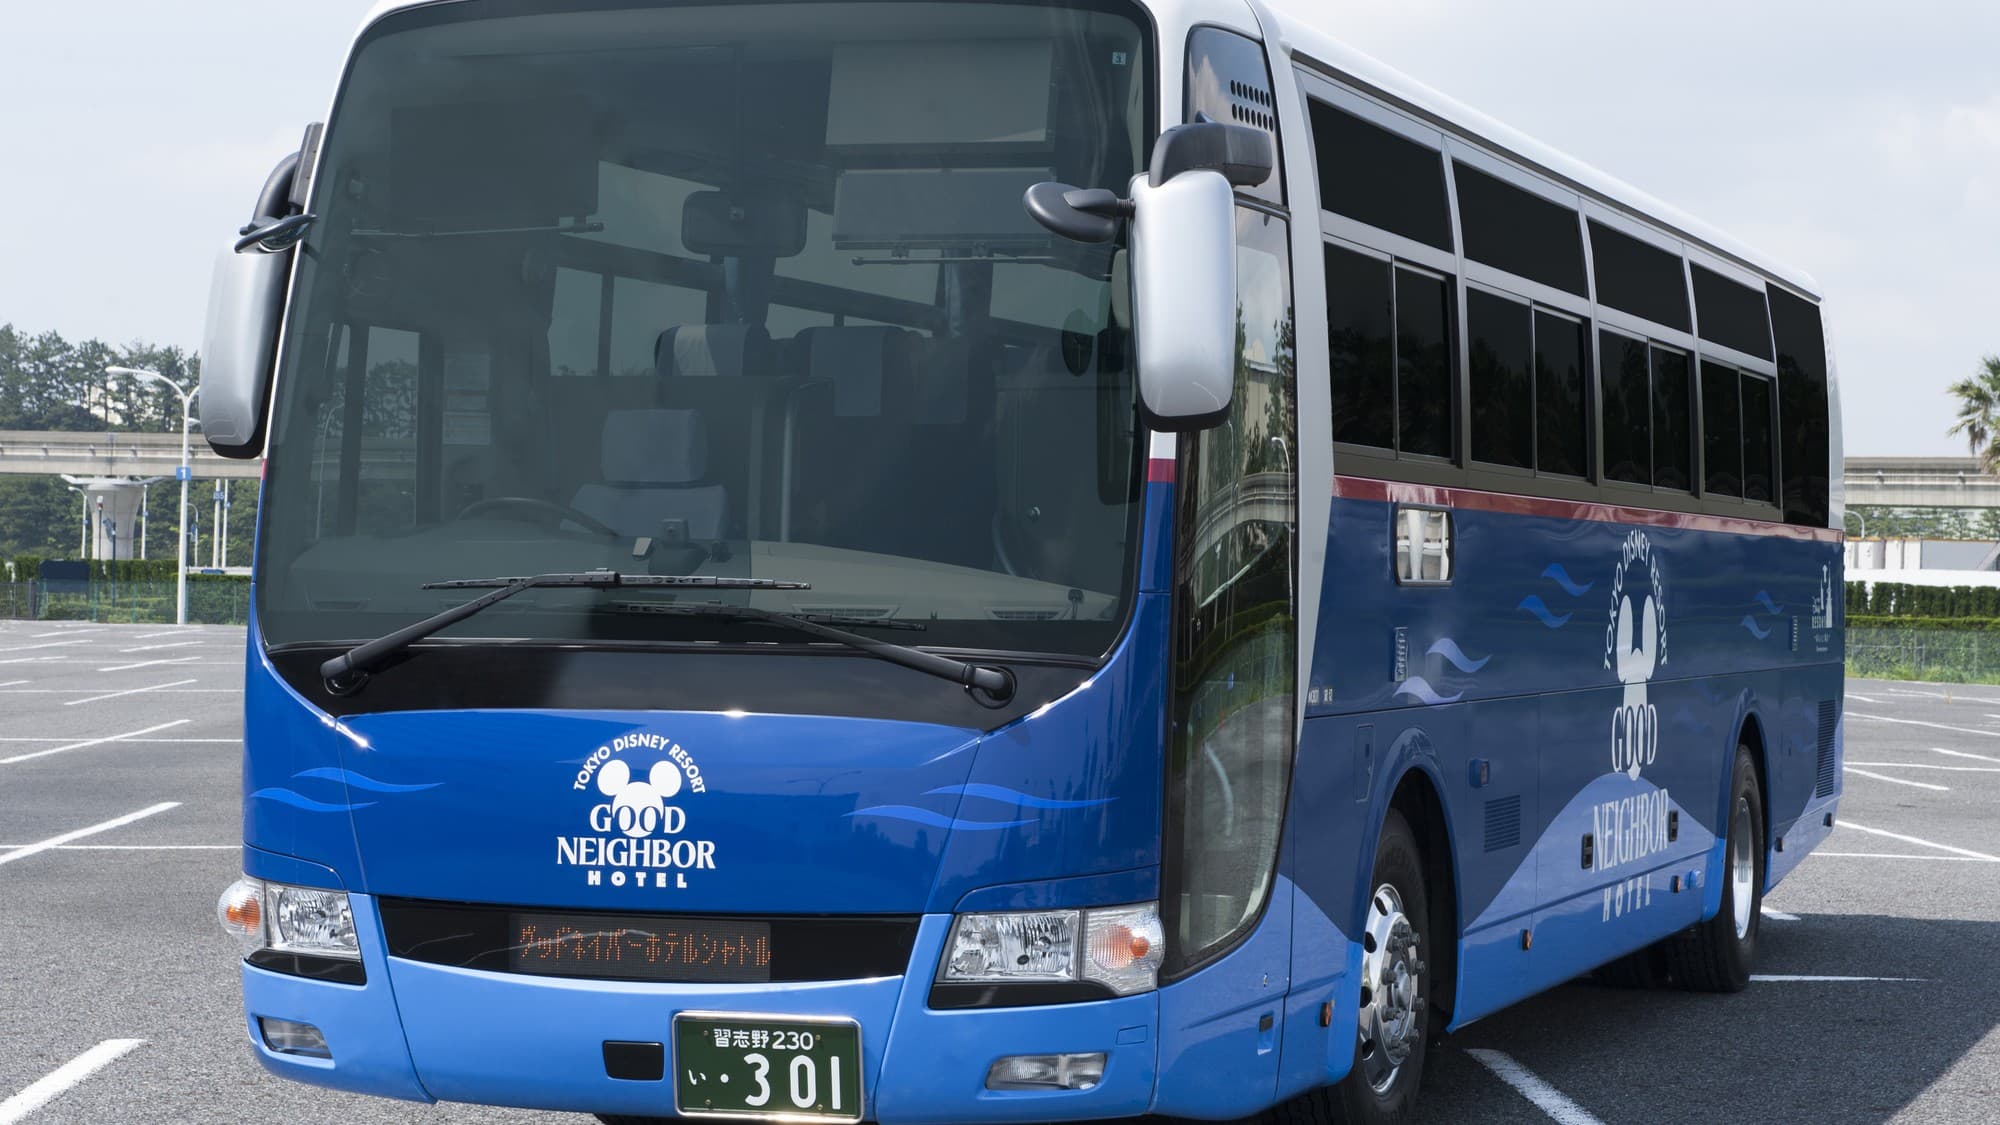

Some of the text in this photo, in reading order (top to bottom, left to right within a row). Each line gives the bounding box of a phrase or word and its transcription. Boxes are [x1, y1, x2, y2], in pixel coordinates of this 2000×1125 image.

[1603, 528, 1668, 671] TOKYO DISNEY RESORT
[574, 733, 706, 794] TOKYO DISNEY RESORT
[1611, 703, 1658, 773] GOOD
[589, 803, 686, 834] GOOD
[1592, 788, 1669, 873] NEIGHBOR
[556, 836, 716, 869] NEIGHBOR
[587, 870, 687, 888] HOTEL
[1602, 873, 1651, 923] HOTEL
